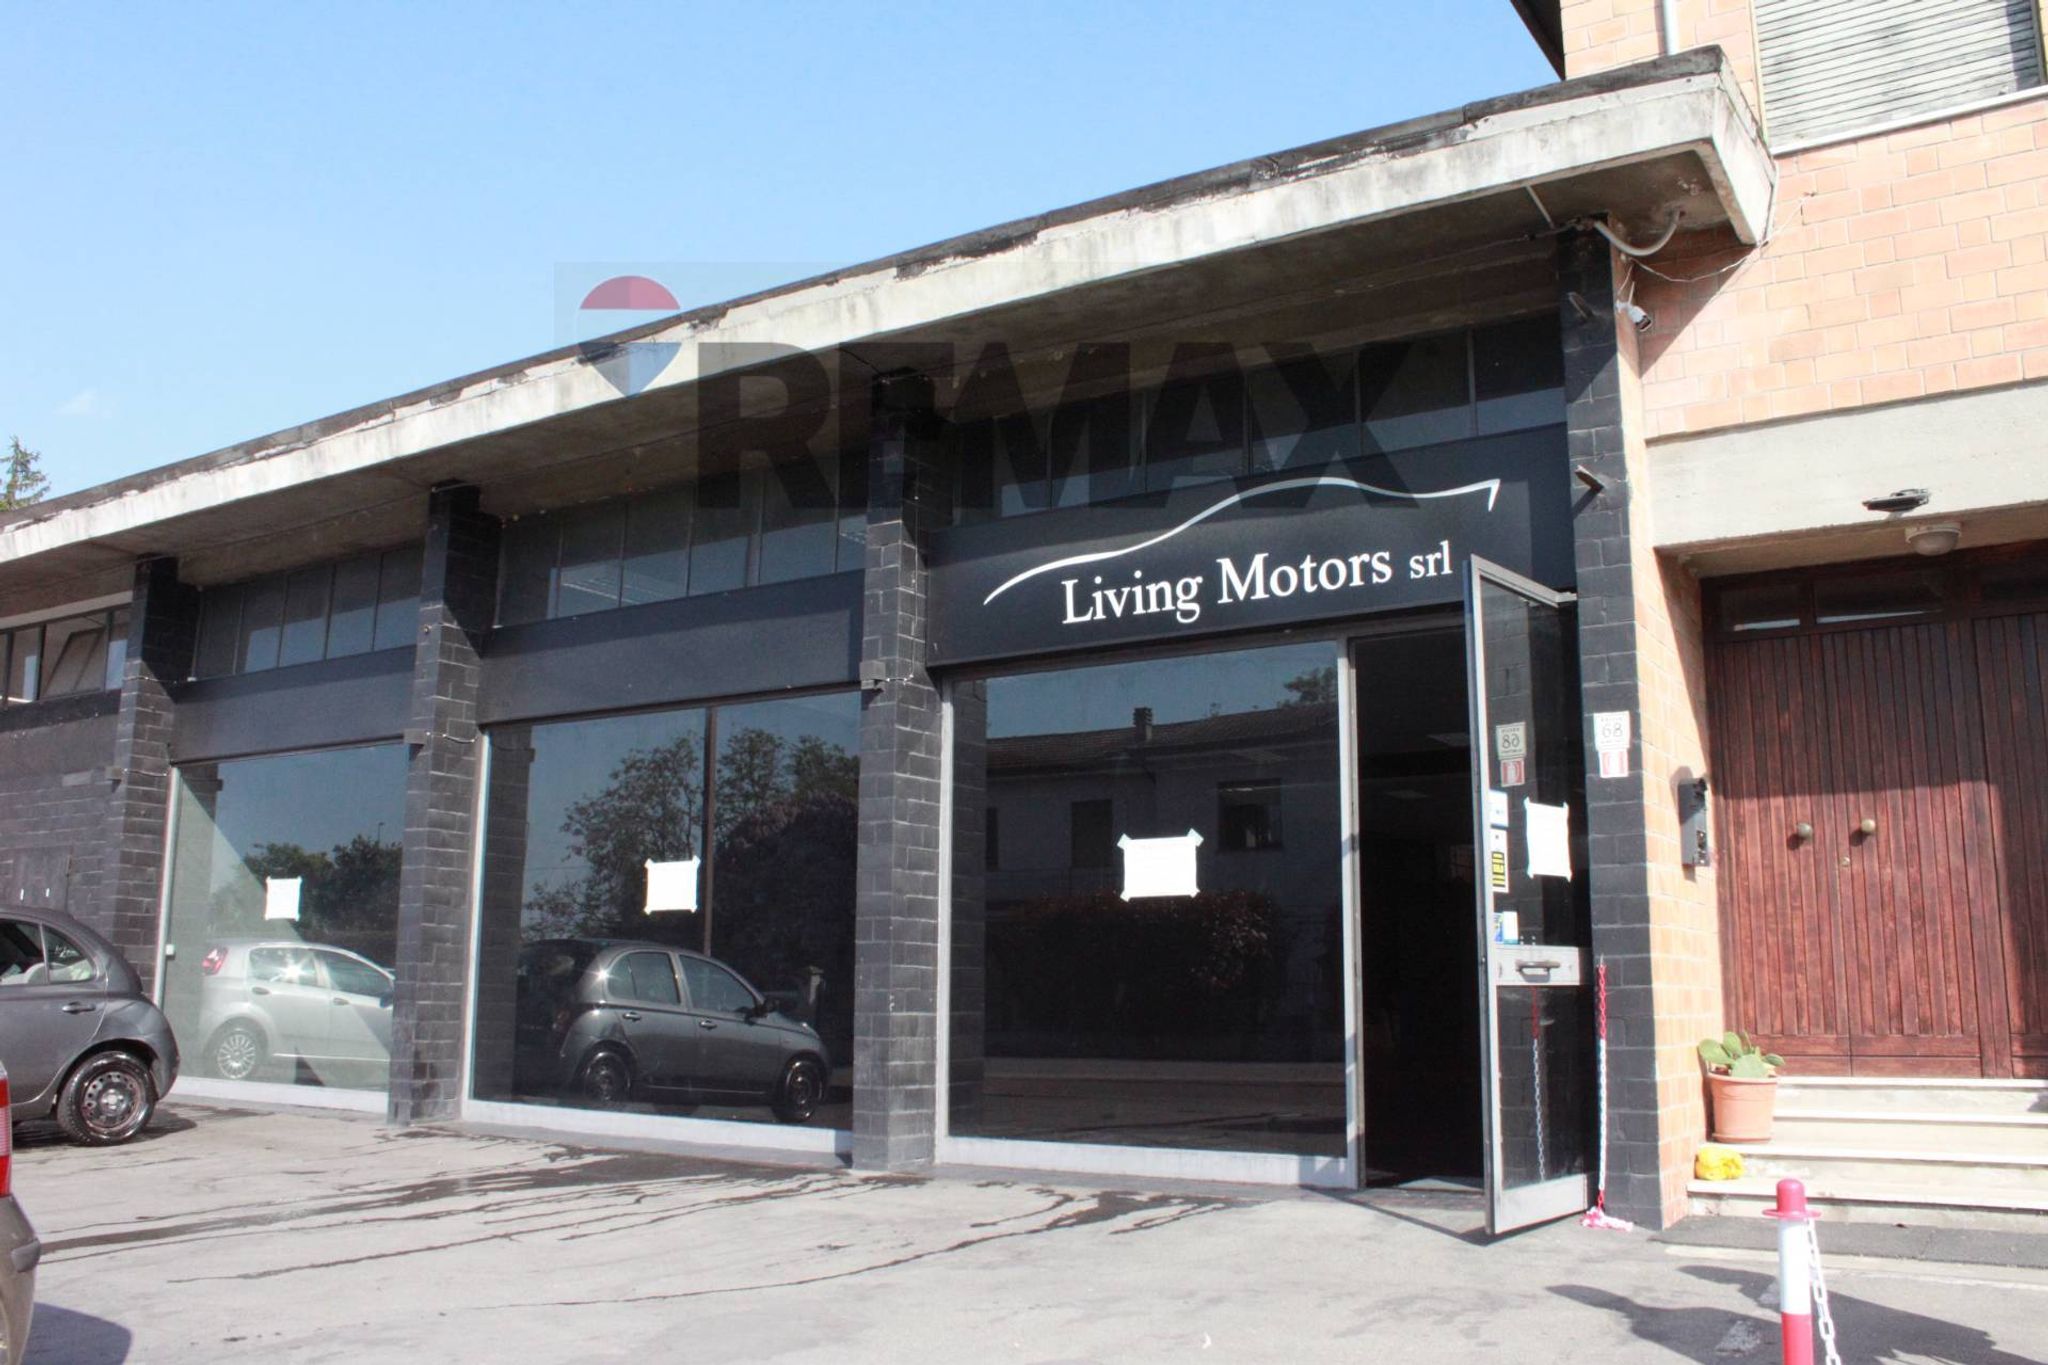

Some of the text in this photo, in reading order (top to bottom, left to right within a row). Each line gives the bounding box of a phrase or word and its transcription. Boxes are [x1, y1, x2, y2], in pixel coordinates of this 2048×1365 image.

[1061, 539, 1453, 624] Living Motors srl
